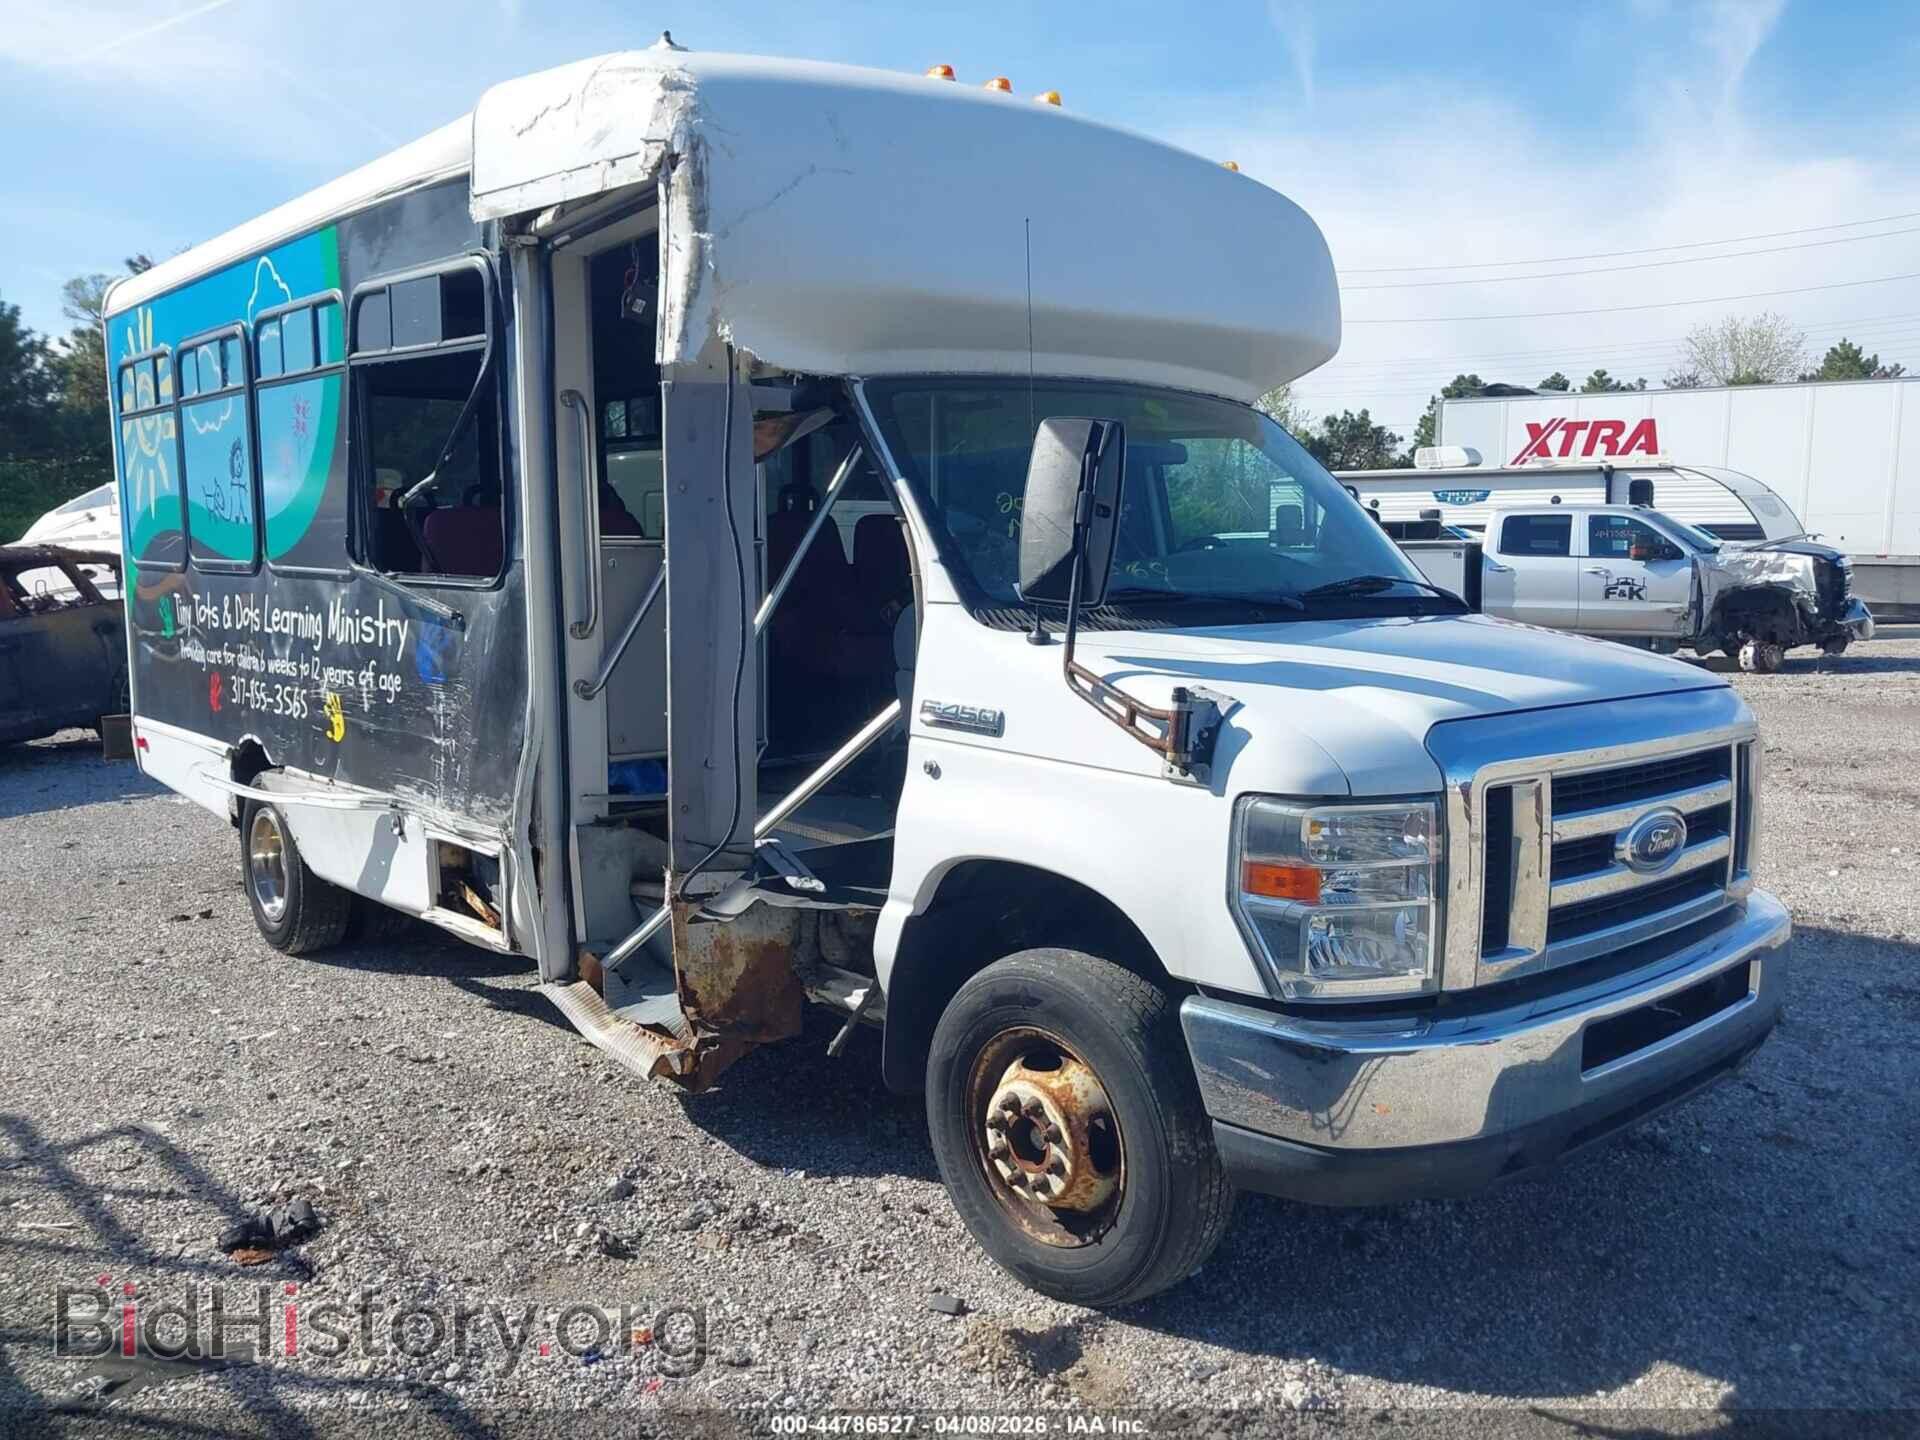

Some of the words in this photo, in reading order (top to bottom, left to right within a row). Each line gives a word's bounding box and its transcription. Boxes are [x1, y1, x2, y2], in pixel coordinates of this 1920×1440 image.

[1511, 417, 1659, 466] XTRA
[1604, 586, 1645, 601] F&K
[173, 592, 192, 637] Tiny
[193, 591, 220, 630] Tots
[222, 594, 233, 631] &
[234, 592, 261, 634] Dots
[263, 593, 323, 652] Learning
[327, 597, 409, 662] Ministry
[206, 649, 222, 665] care
[222, 641, 236, 667] for
[258, 648, 266, 673] 6
[267, 648, 298, 677] weeks
[299, 652, 310, 680] to
[311, 655, 320, 681] 12
[321, 665, 355, 690] years
[378, 672, 402, 704] age
[230, 675, 308, 719] 317-855-3565
[1647, 828, 1677, 856] Ford
